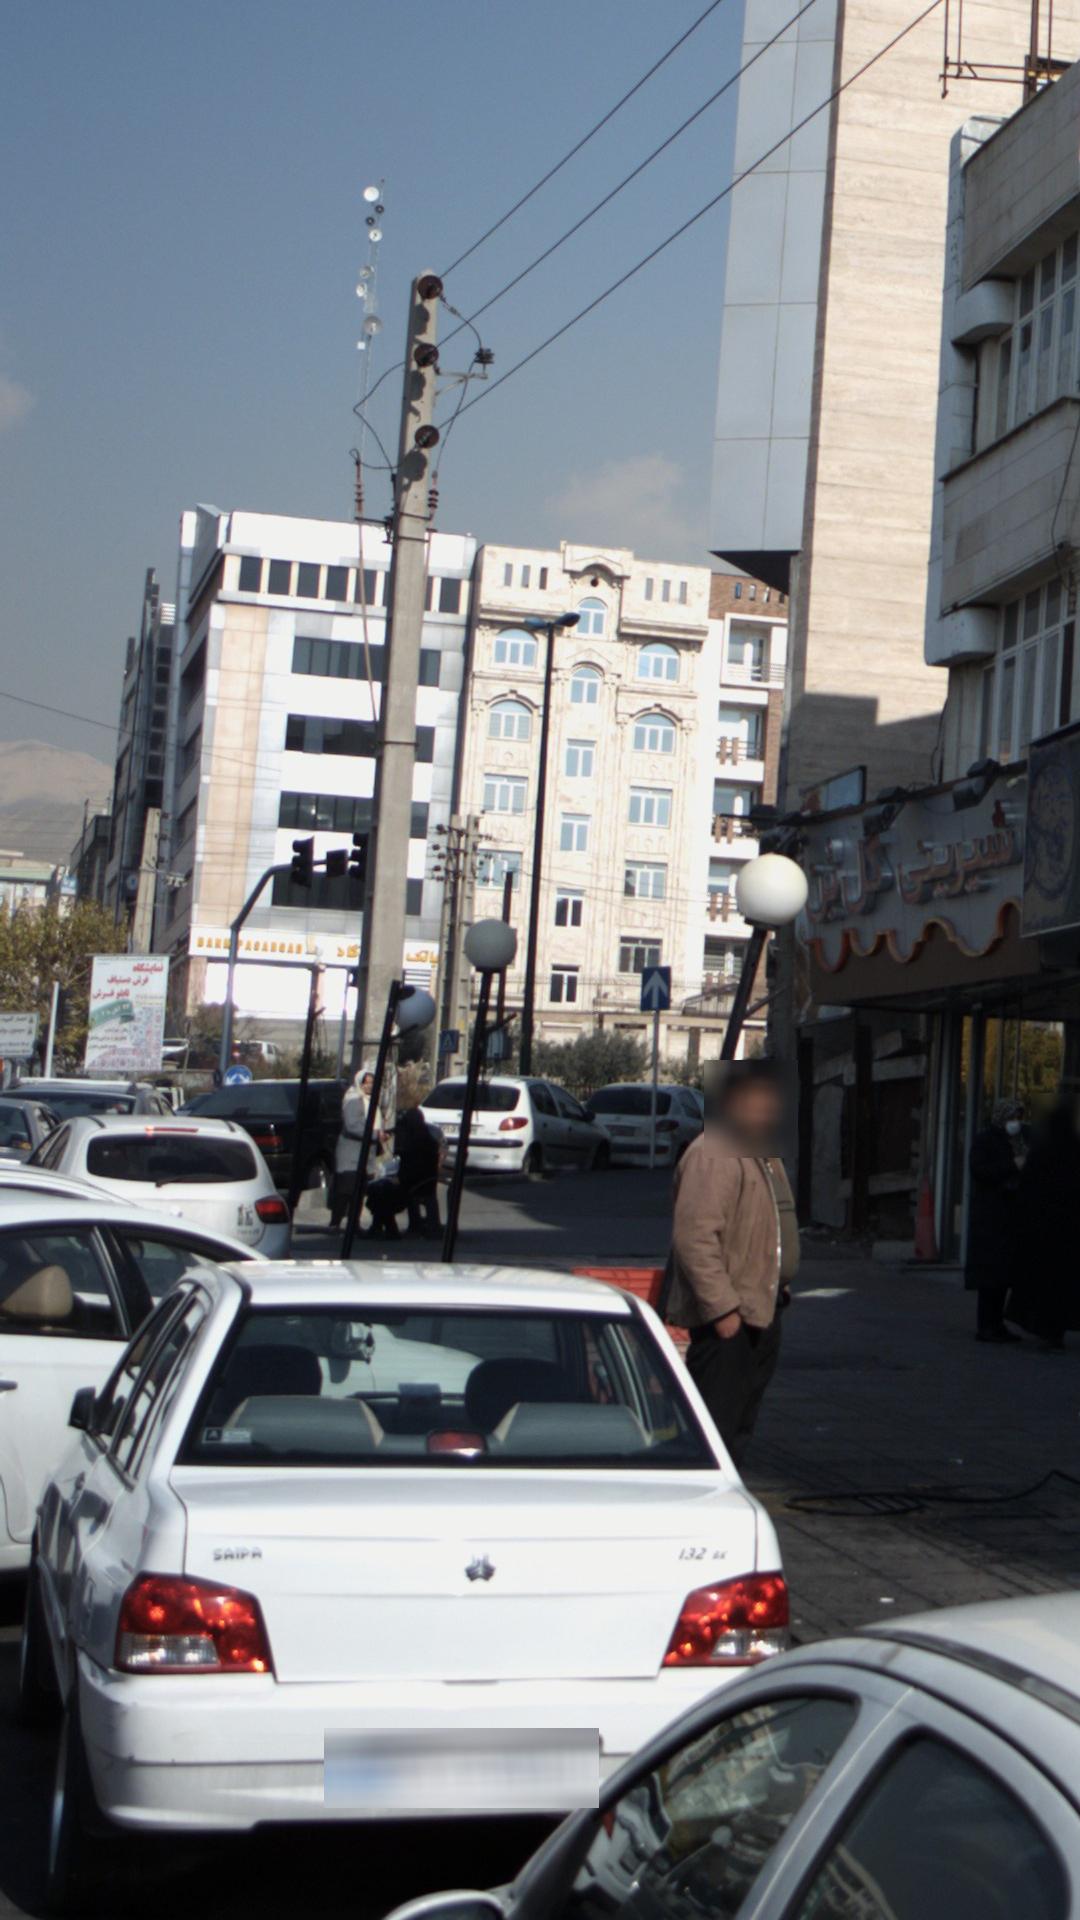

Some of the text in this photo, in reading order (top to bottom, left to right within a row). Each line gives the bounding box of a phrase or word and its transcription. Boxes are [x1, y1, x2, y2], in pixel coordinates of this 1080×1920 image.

[132, 962, 164, 974] نمایشگاه
[213, 1547, 263, 1561] SAIPA
[678, 1547, 707, 1560] 132
